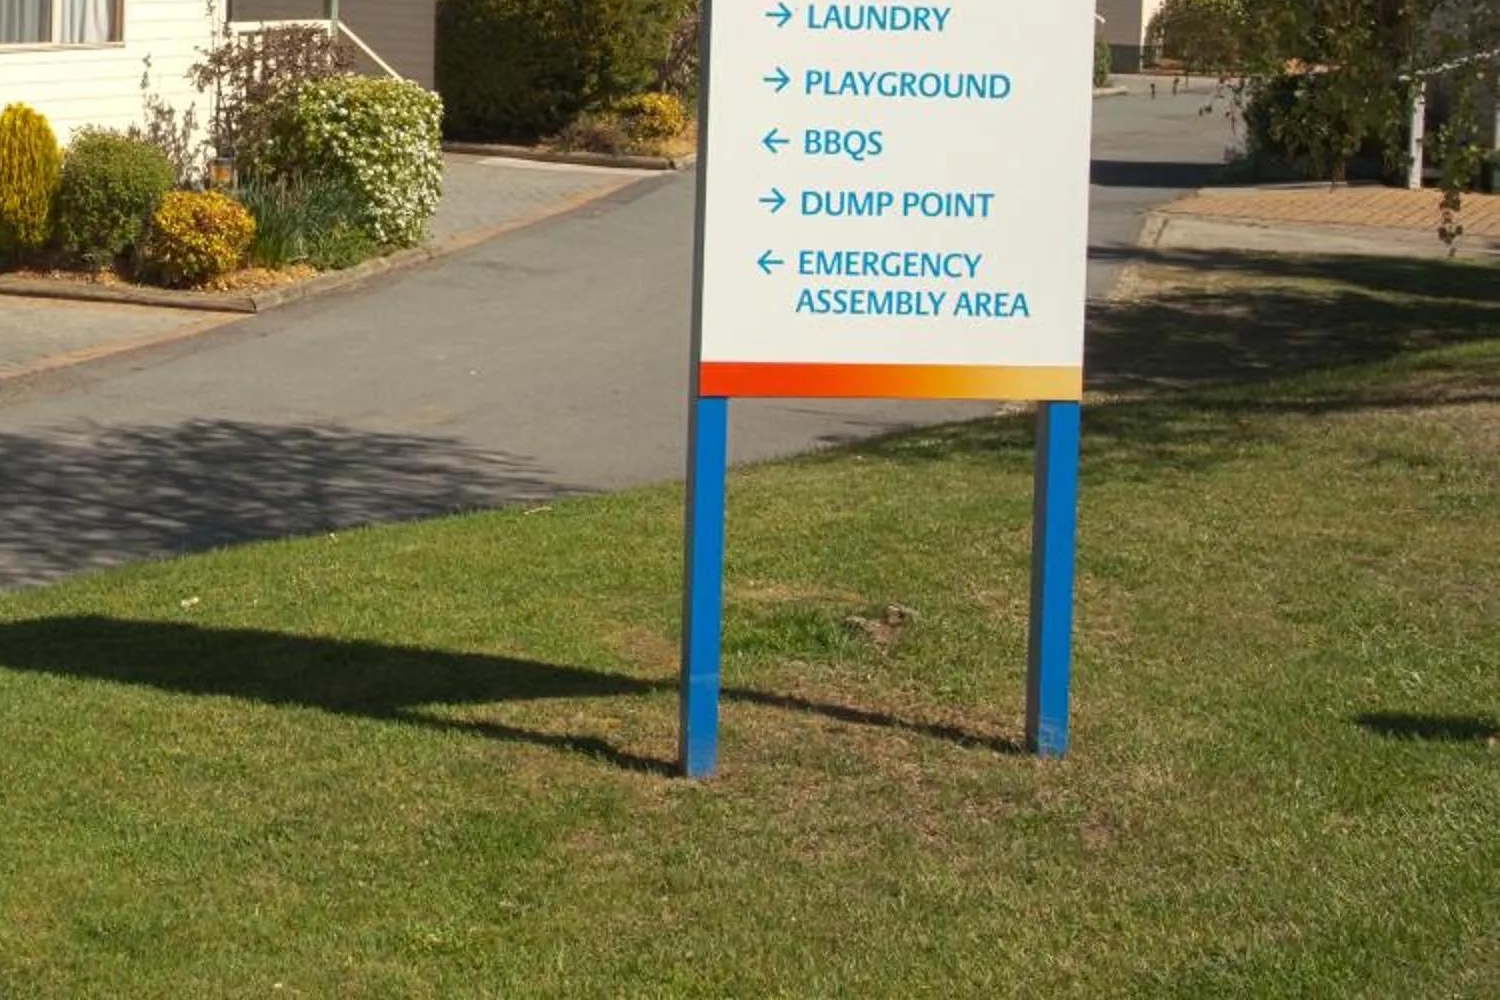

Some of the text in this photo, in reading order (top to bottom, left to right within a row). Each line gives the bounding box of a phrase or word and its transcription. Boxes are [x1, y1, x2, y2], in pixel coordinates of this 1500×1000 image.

[807, 4, 951, 32] LAUNDRY
[805, 69, 1011, 99] PLAYGROUND
[803, 129, 883, 162] BBQS
[801, 190, 995, 218] DUMP POINT
[798, 249, 982, 279] EMERGENCY
[795, 288, 1030, 318] ASSEMBLY AREA
